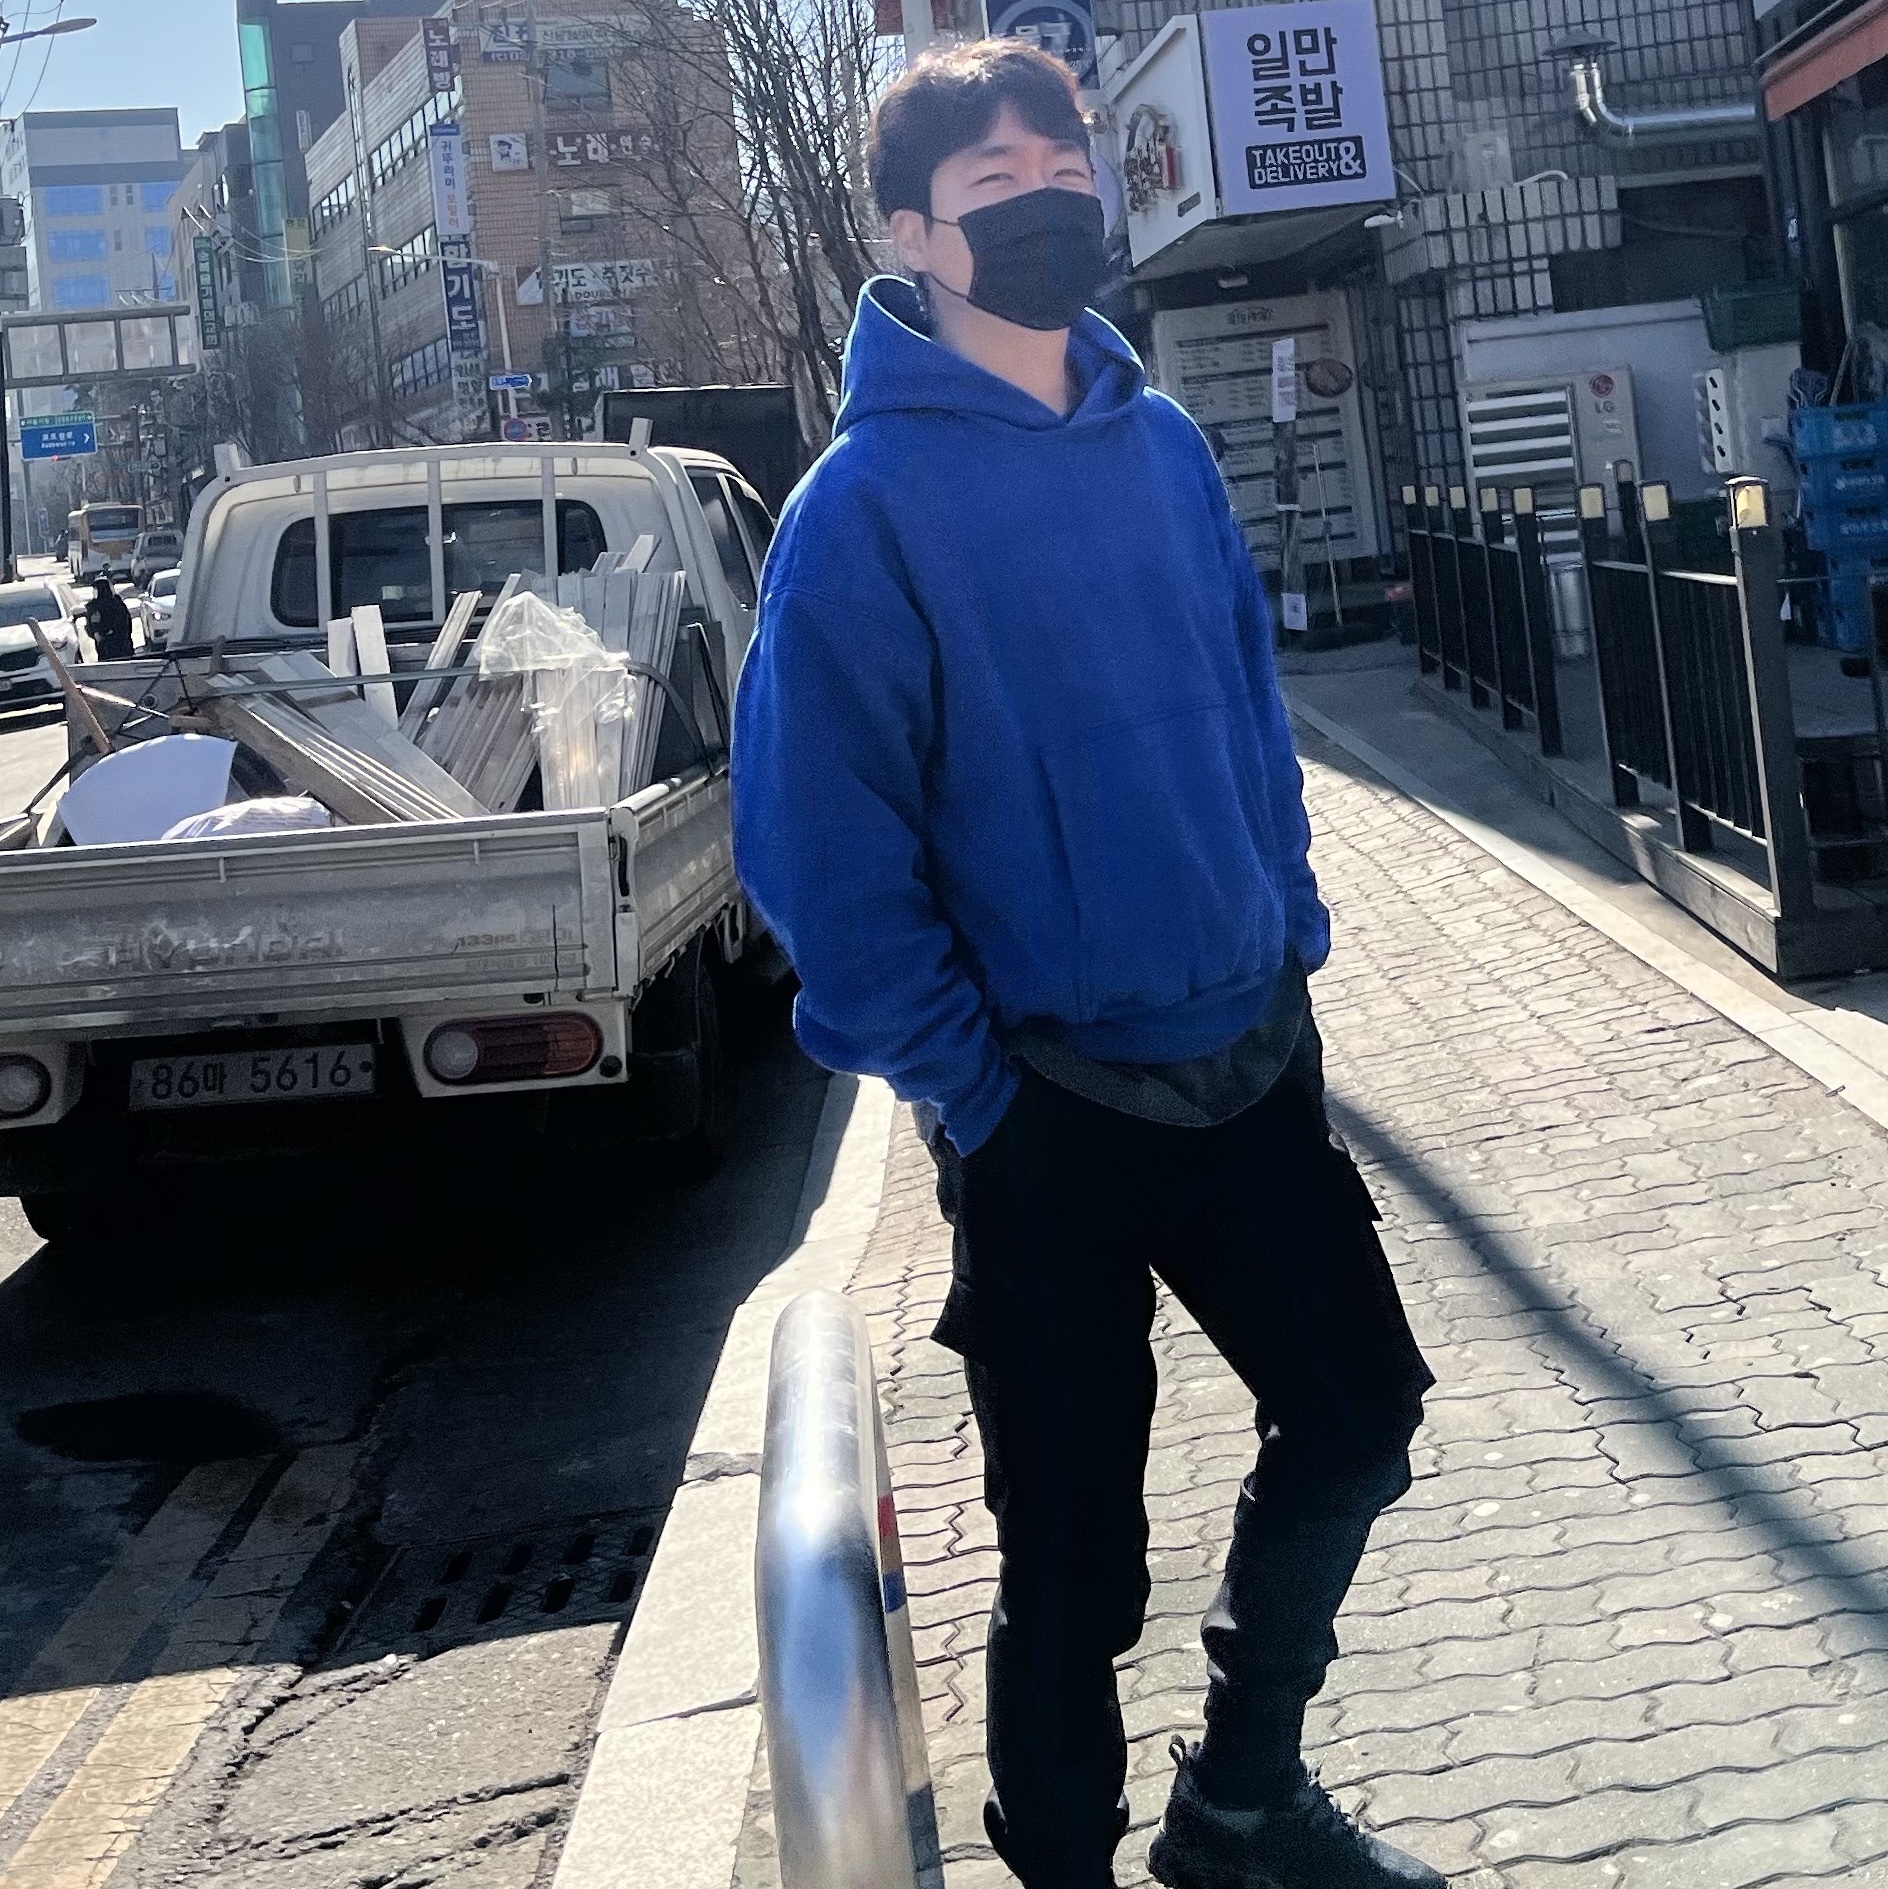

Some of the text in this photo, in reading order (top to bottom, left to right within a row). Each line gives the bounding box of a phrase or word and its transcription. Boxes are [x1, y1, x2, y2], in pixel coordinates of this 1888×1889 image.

[428, 29, 451, 90] 노래방
[1247, 27, 1338, 81] 일만
[1253, 81, 1343, 133] 족발
[441, 141, 455, 189] 귀뚜라미
[1252, 141, 1364, 176] TAKEOUT &
[1254, 160, 1341, 185] DELIVERY
[447, 194, 460, 229] 보일러
[443, 243, 476, 330] 합기도
[1593, 401, 1615, 413] LG
[151, 1050, 352, 1099] 86마 5616
